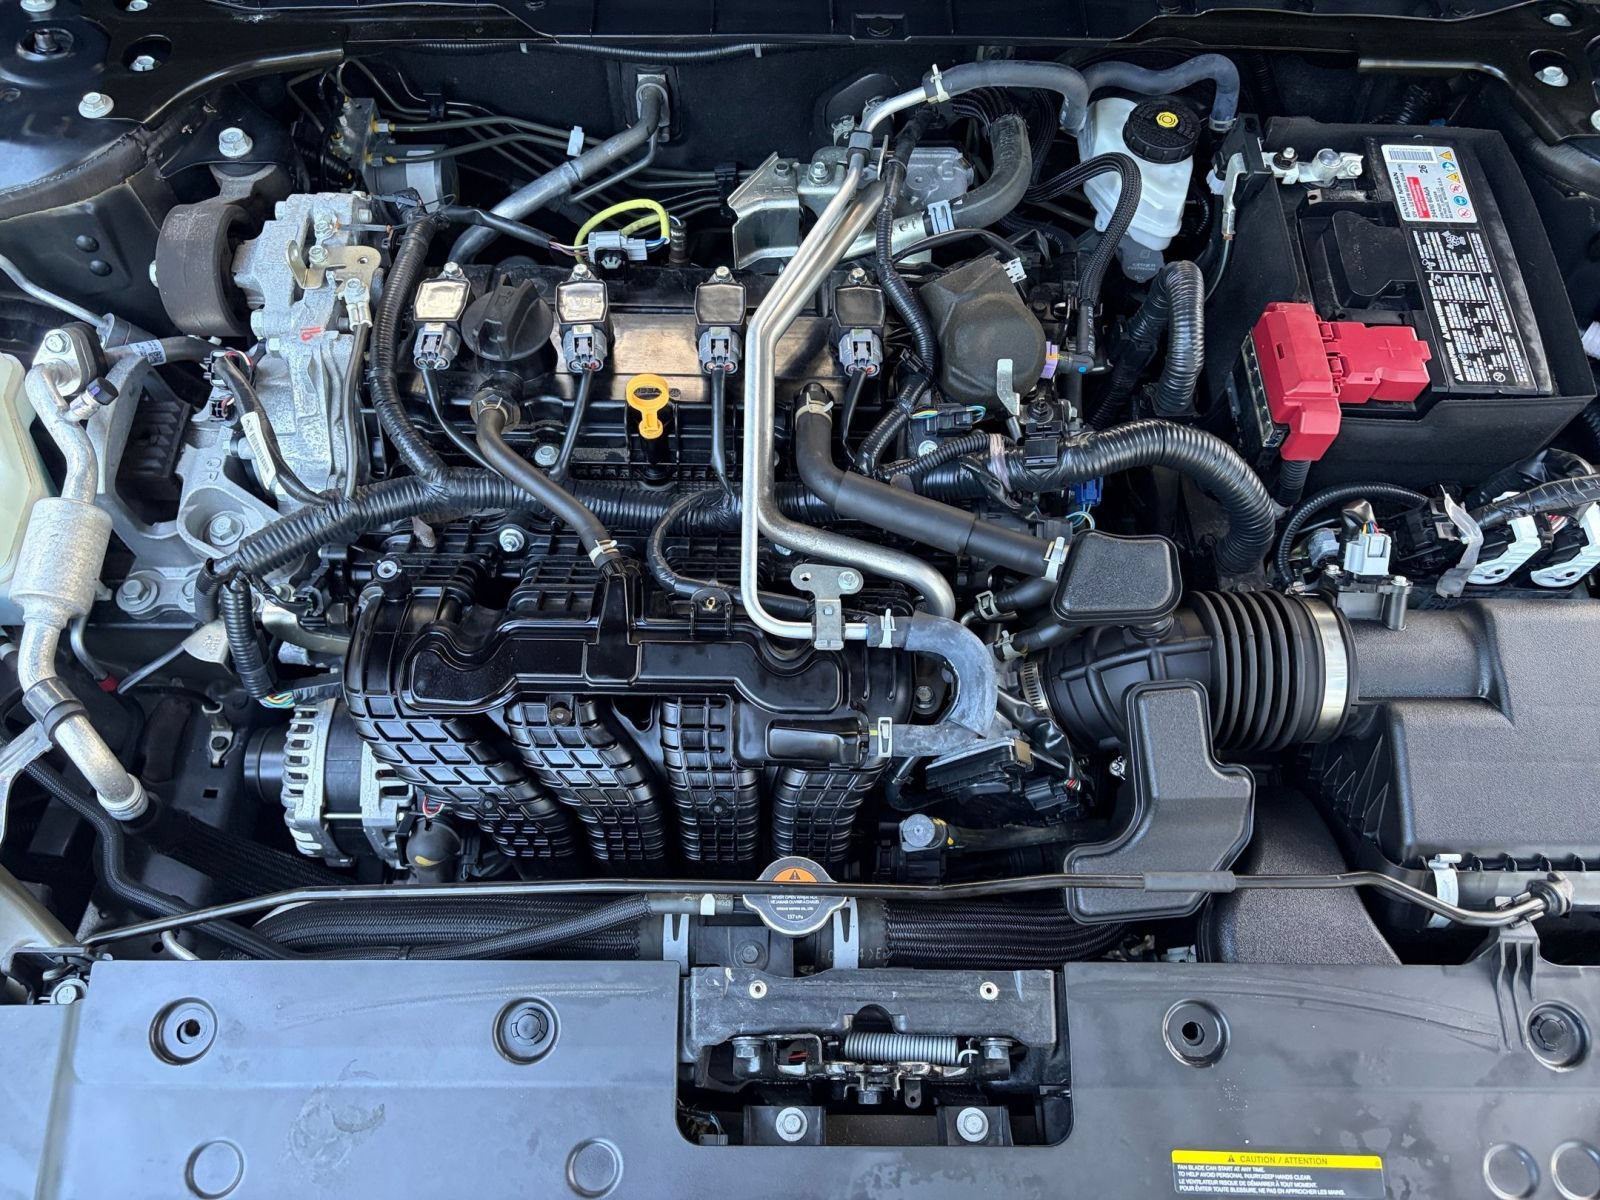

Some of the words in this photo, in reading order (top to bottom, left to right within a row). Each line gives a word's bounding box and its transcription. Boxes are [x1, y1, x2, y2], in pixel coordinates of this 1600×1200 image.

[1417, 164, 1428, 173] 26
[1392, 172, 1403, 193] NISSAN
[1399, 196, 1410, 217] RENAULT
[1239, 1155, 1275, 1163] CAUTION
[1284, 1156, 1327, 1164] ATTENTION
[1195, 1184, 1212, 1192] ÉVITER
